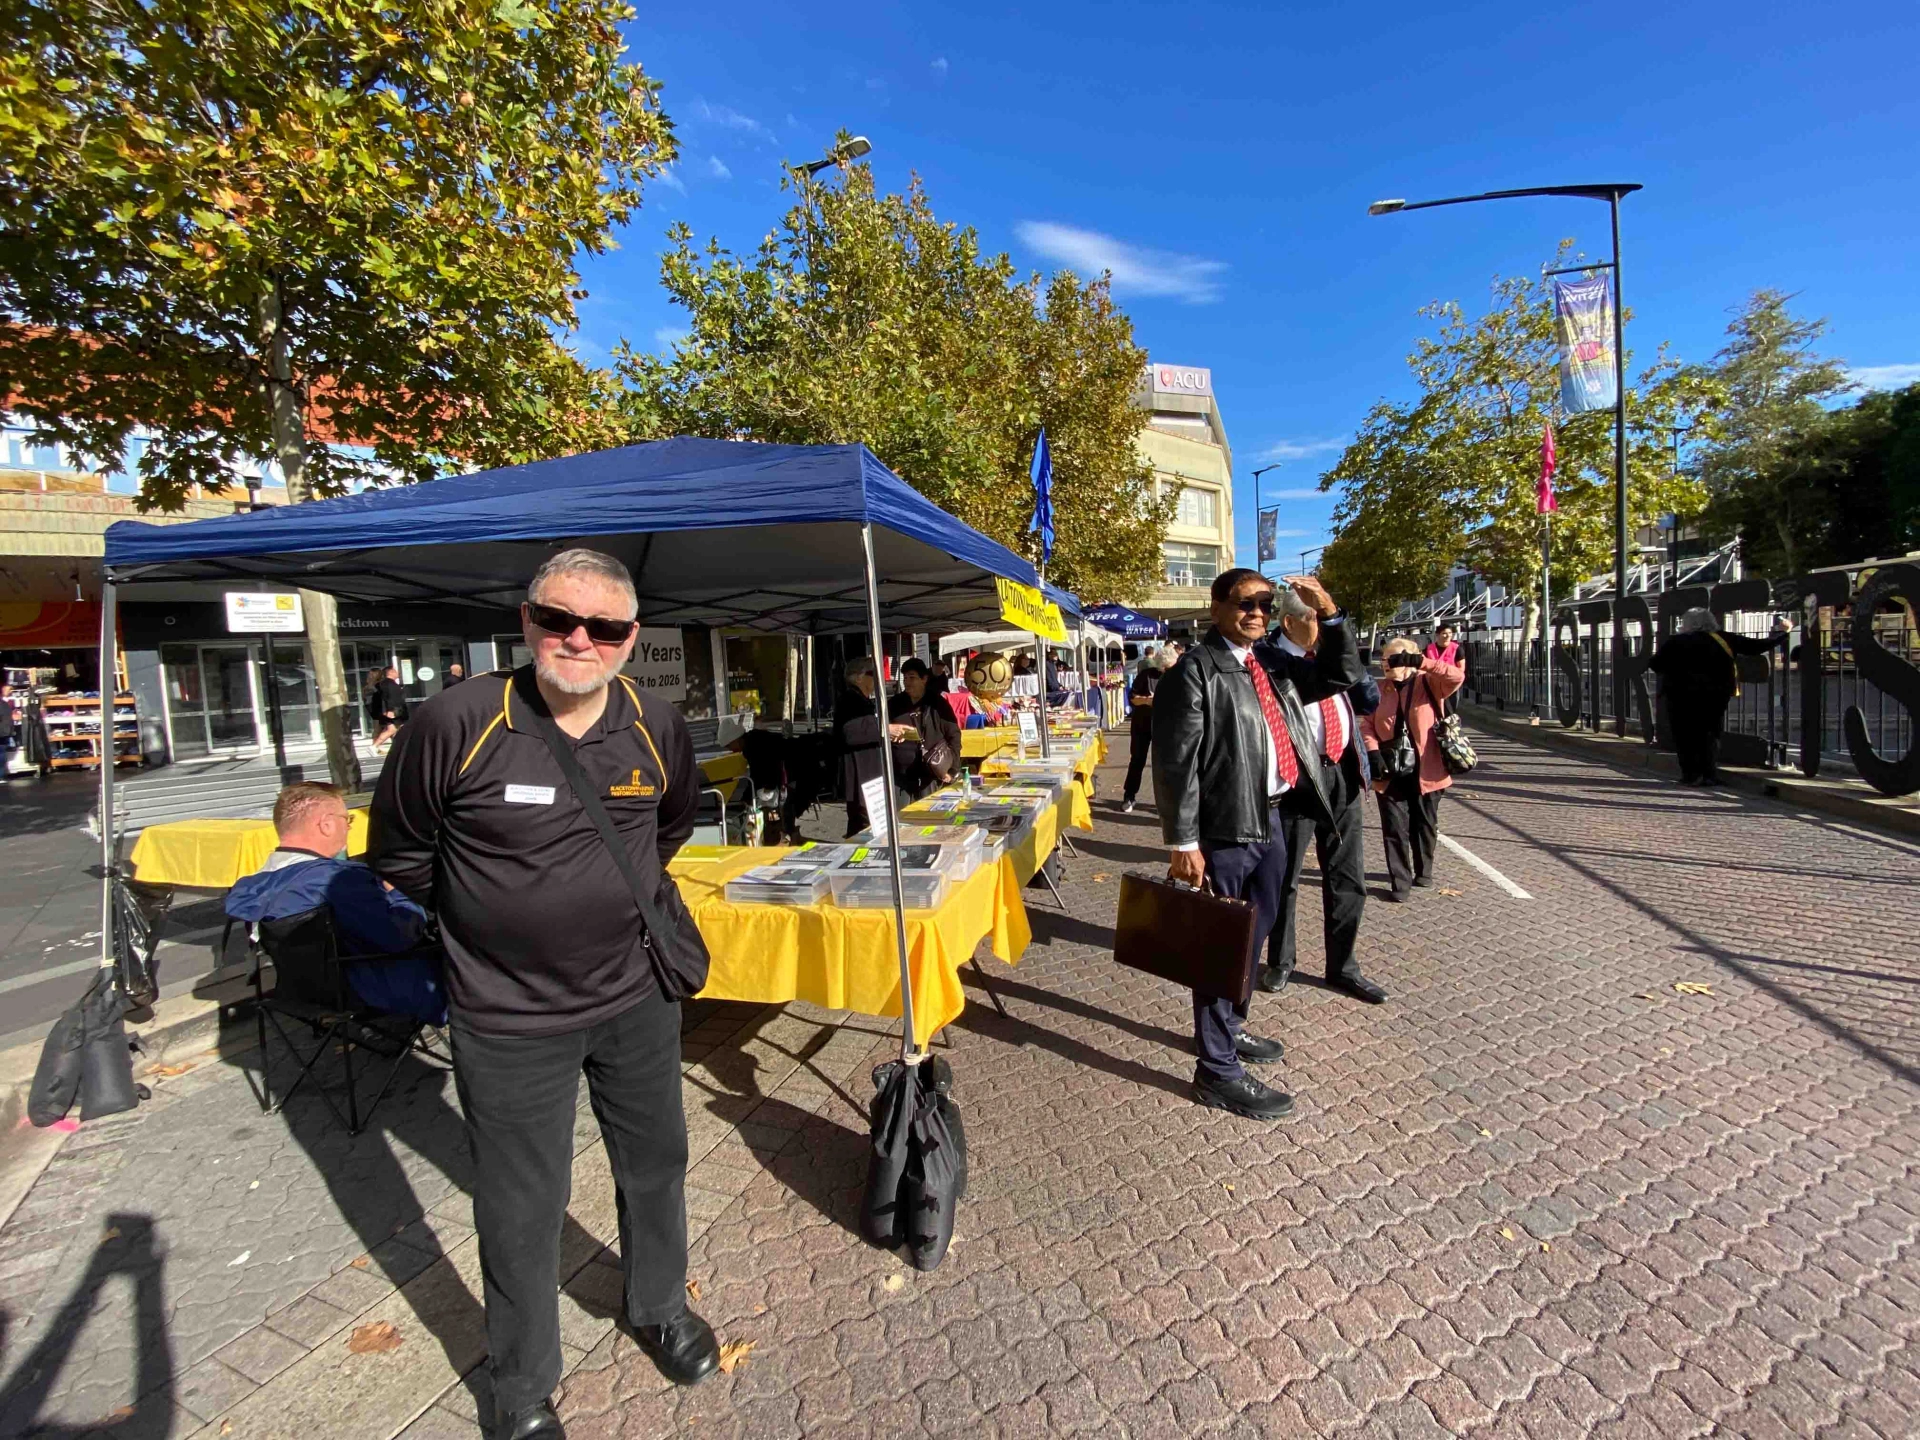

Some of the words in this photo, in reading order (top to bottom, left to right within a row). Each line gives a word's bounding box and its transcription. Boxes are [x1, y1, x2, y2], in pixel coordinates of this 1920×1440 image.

[1173, 371, 1206, 389] ACU
[1085, 613, 1119, 621] ATER
[1126, 626, 1154, 634] WATER
[641, 642, 682, 663] Years
[971, 660, 1006, 685] 50
[647, 676, 656, 688] to
[658, 674, 680, 687] 2026
